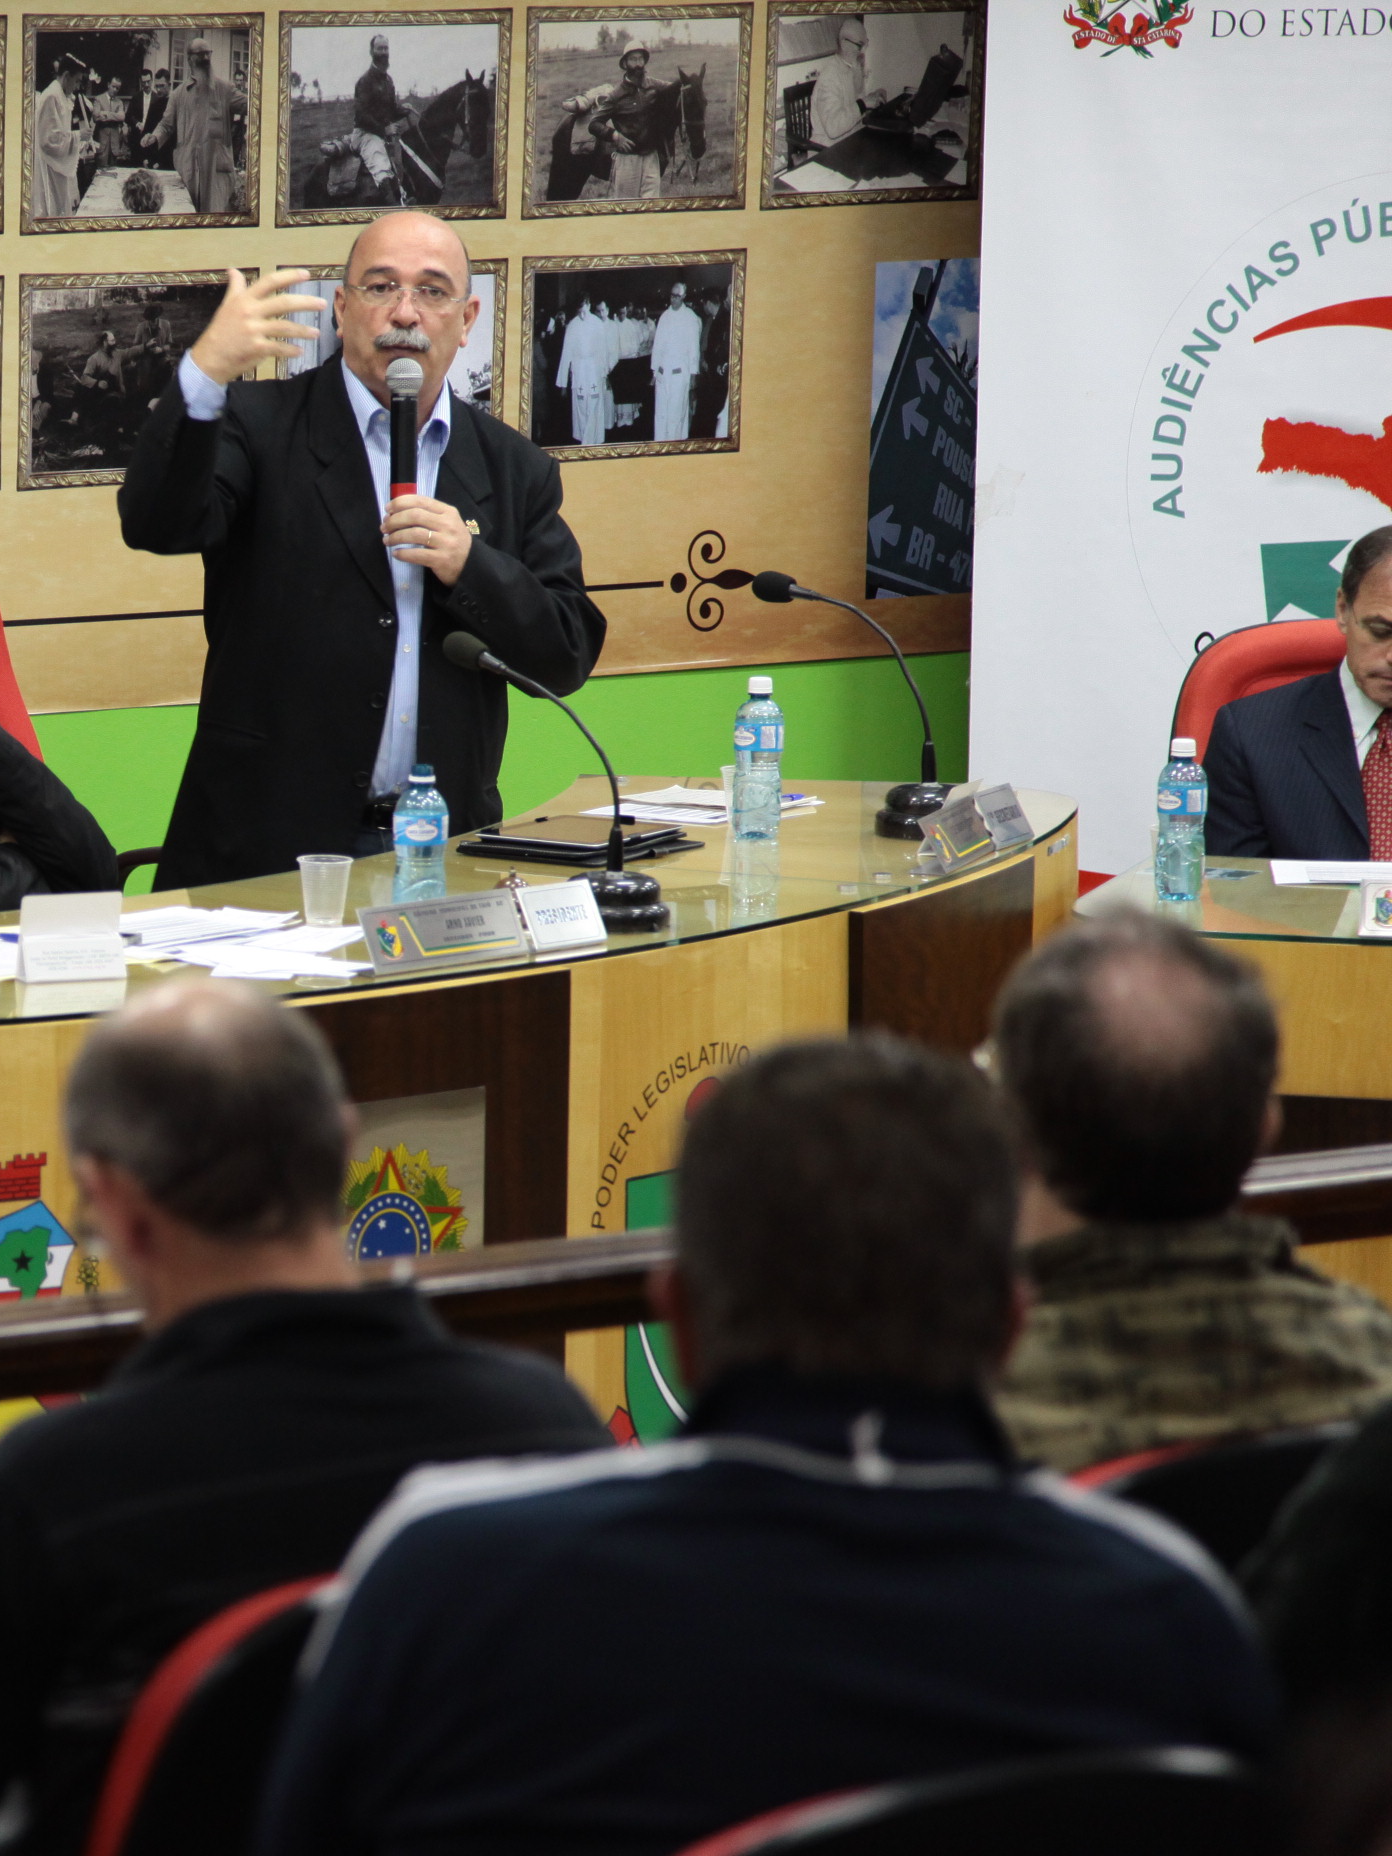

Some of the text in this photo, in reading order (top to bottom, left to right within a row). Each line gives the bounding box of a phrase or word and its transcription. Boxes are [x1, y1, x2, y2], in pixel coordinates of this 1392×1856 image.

[1075, 30, 1106, 41] ESTADO
[1133, 36, 1146, 45] STA
[1147, 30, 1180, 41] CATARINA
[1210, 8, 1392, 38] DO ESTAD
[1150, 240, 1300, 519] AUDIÊNCIAS
[943, 385, 964, 425] SC
[932, 482, 965, 531] RUA
[906, 525, 935, 570] BR
[591, 1042, 750, 1230] PODER LEGISLATIVO
